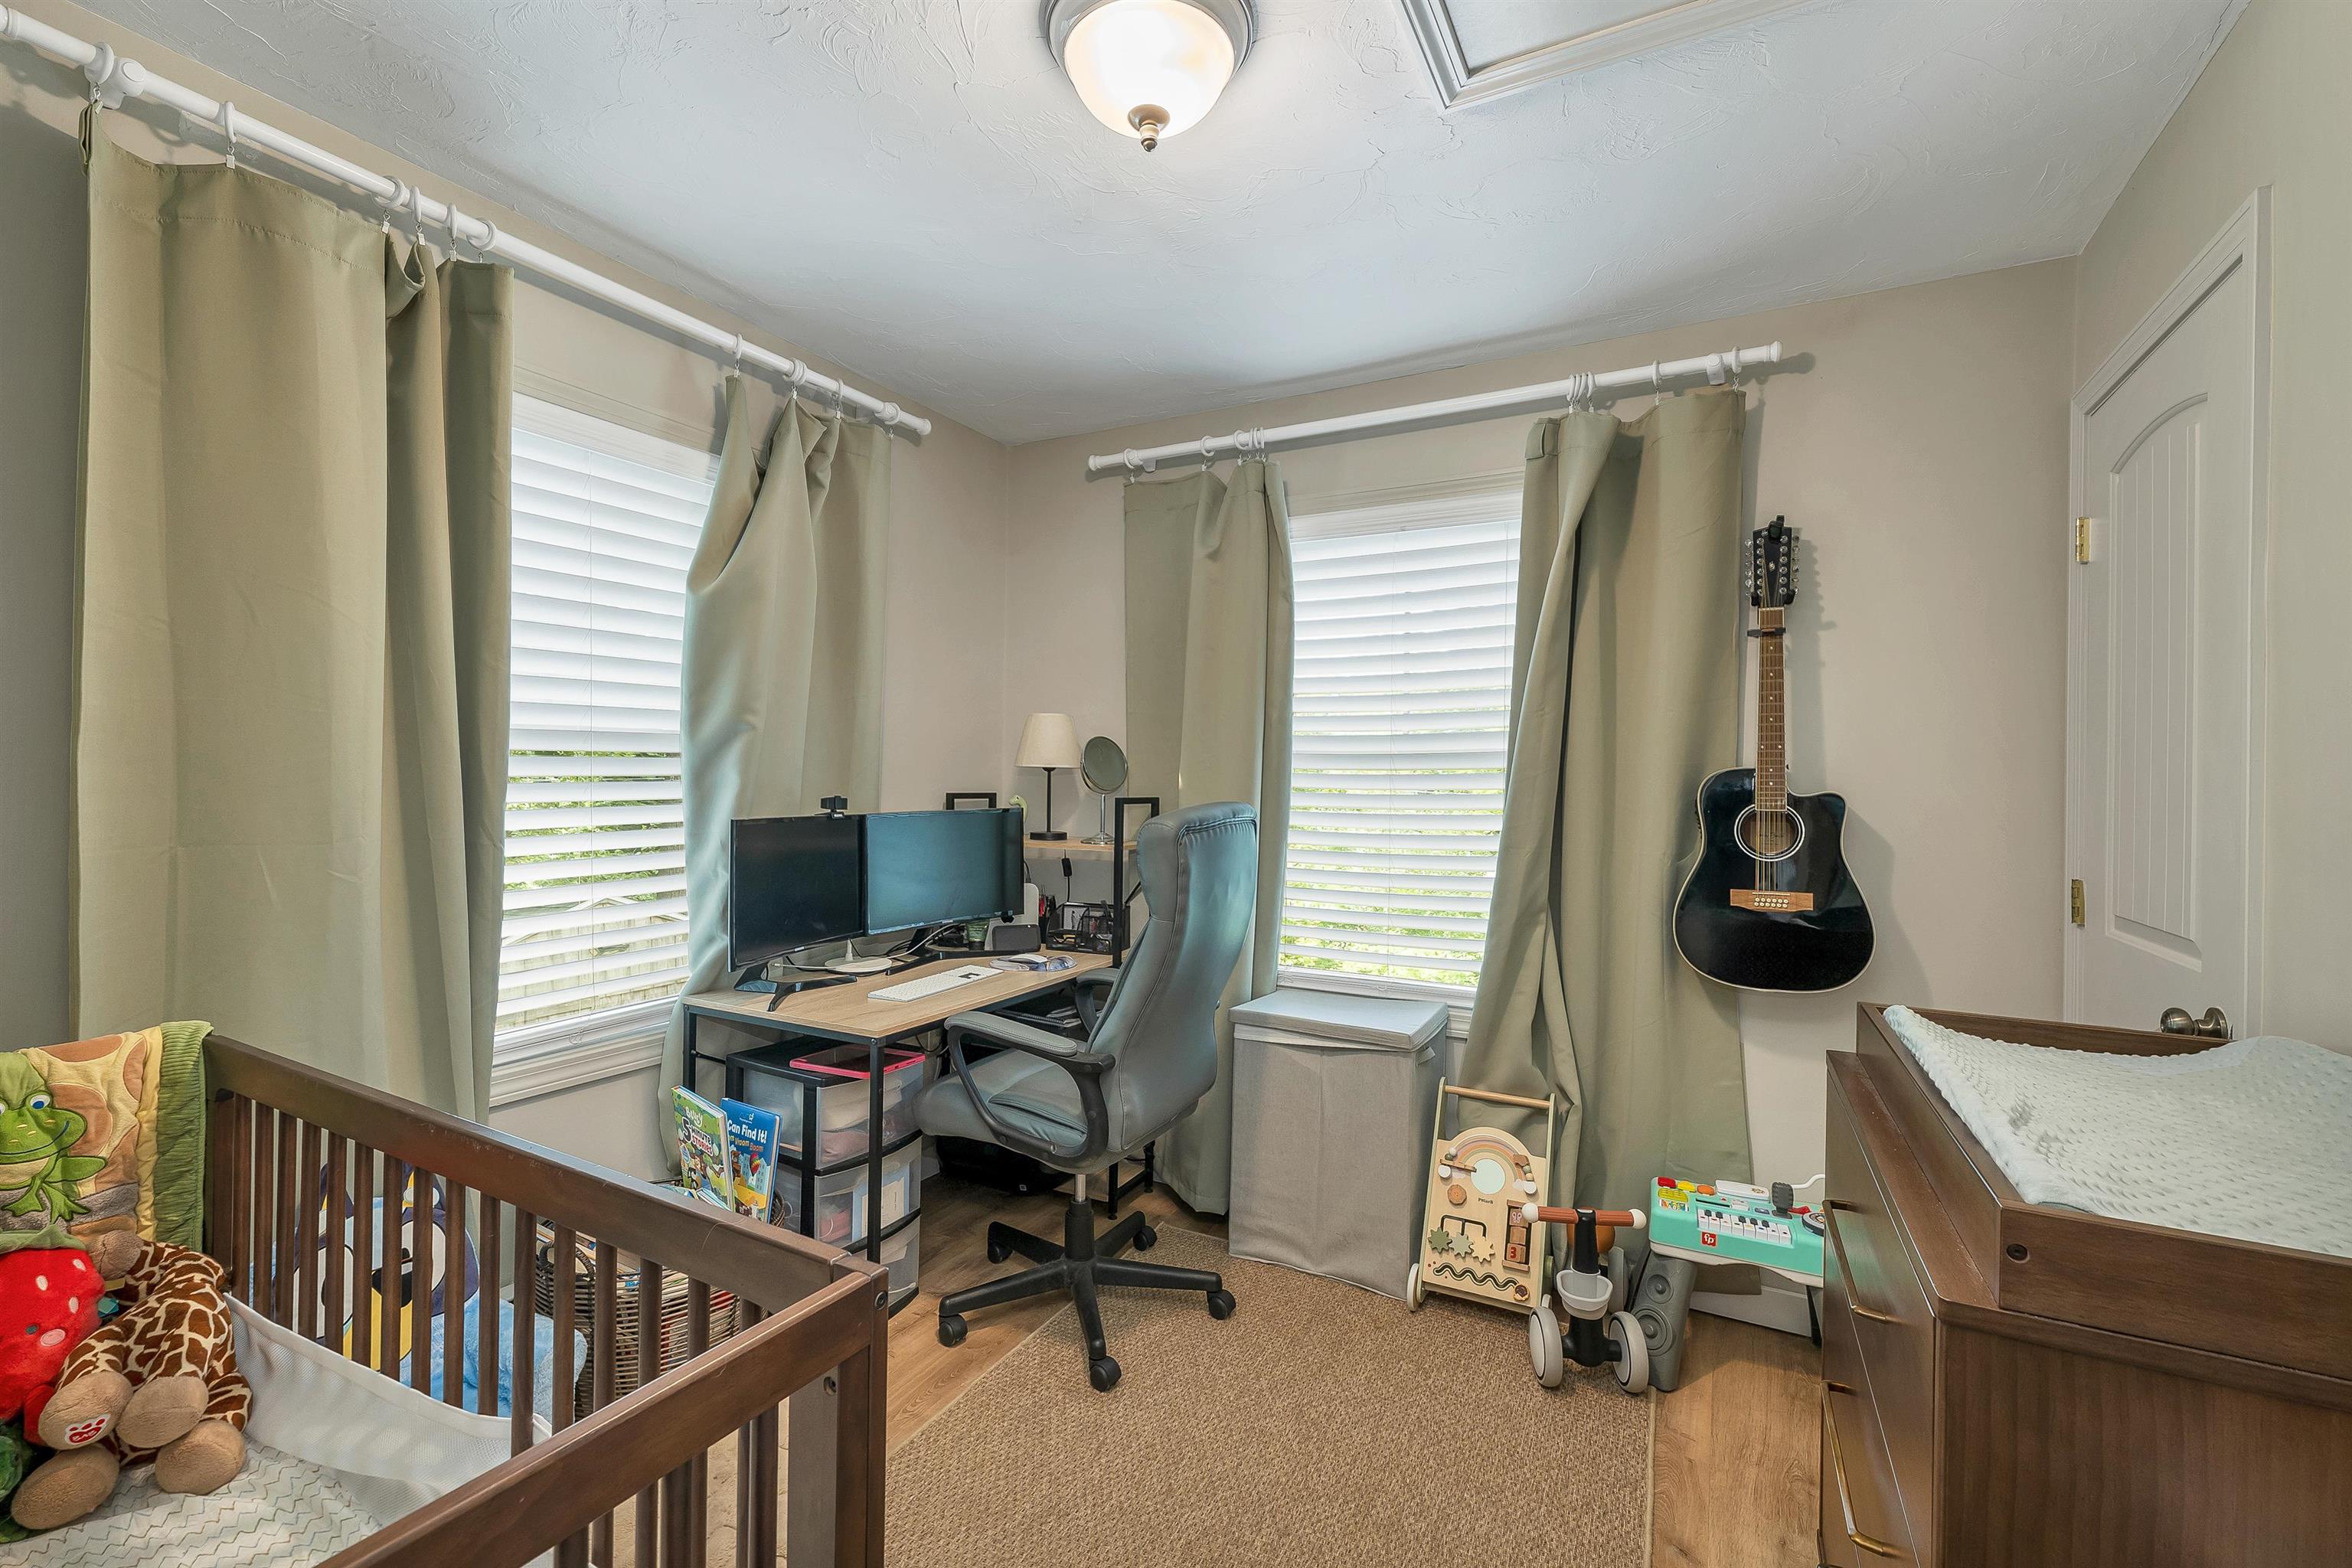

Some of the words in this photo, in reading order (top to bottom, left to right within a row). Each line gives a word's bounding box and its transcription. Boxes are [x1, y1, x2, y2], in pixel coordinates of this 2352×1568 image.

[685, 1106, 703, 1127] Bluey
[727, 1119, 740, 1134] Can
[741, 1124, 756, 1141] Find
[758, 1129, 767, 1144] It!
[692, 1135, 712, 1155] STORIES
[735, 1137, 750, 1147] Vroom
[1704, 1233, 1714, 1244] fp
[1510, 1246, 1517, 1259] 3
